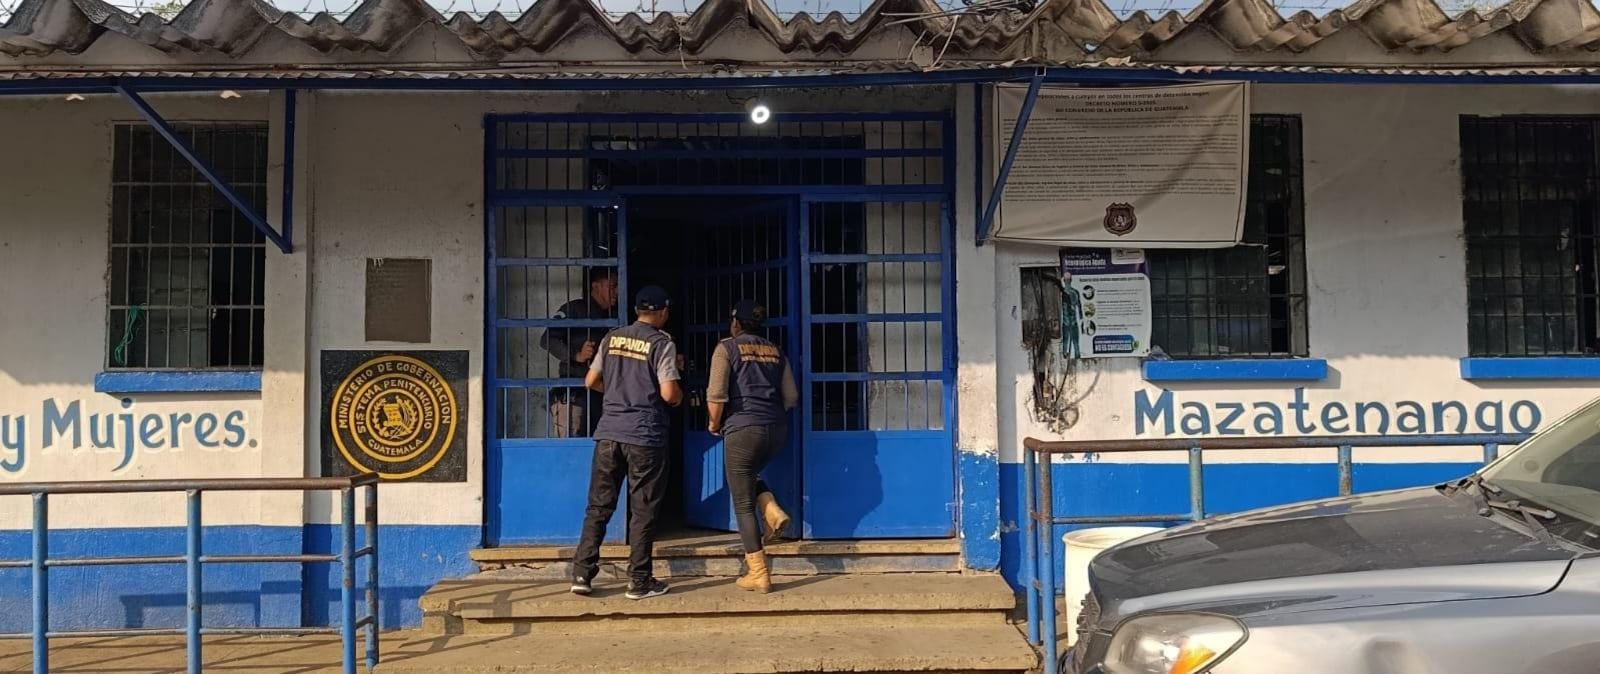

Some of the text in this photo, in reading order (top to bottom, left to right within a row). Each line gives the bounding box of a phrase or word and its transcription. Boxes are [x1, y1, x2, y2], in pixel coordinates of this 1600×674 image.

[609, 336, 651, 354] DIPANDA
[339, 369, 373, 428] MINISTERIO
[377, 362, 393, 372] DE
[356, 379, 433, 433] SISTEMA PENITENCIARIO
[1134, 387, 1542, 435] Mazatenango
[0, 397, 258, 473] y Mujeres.
[368, 439, 423, 456] GUATEMALA
